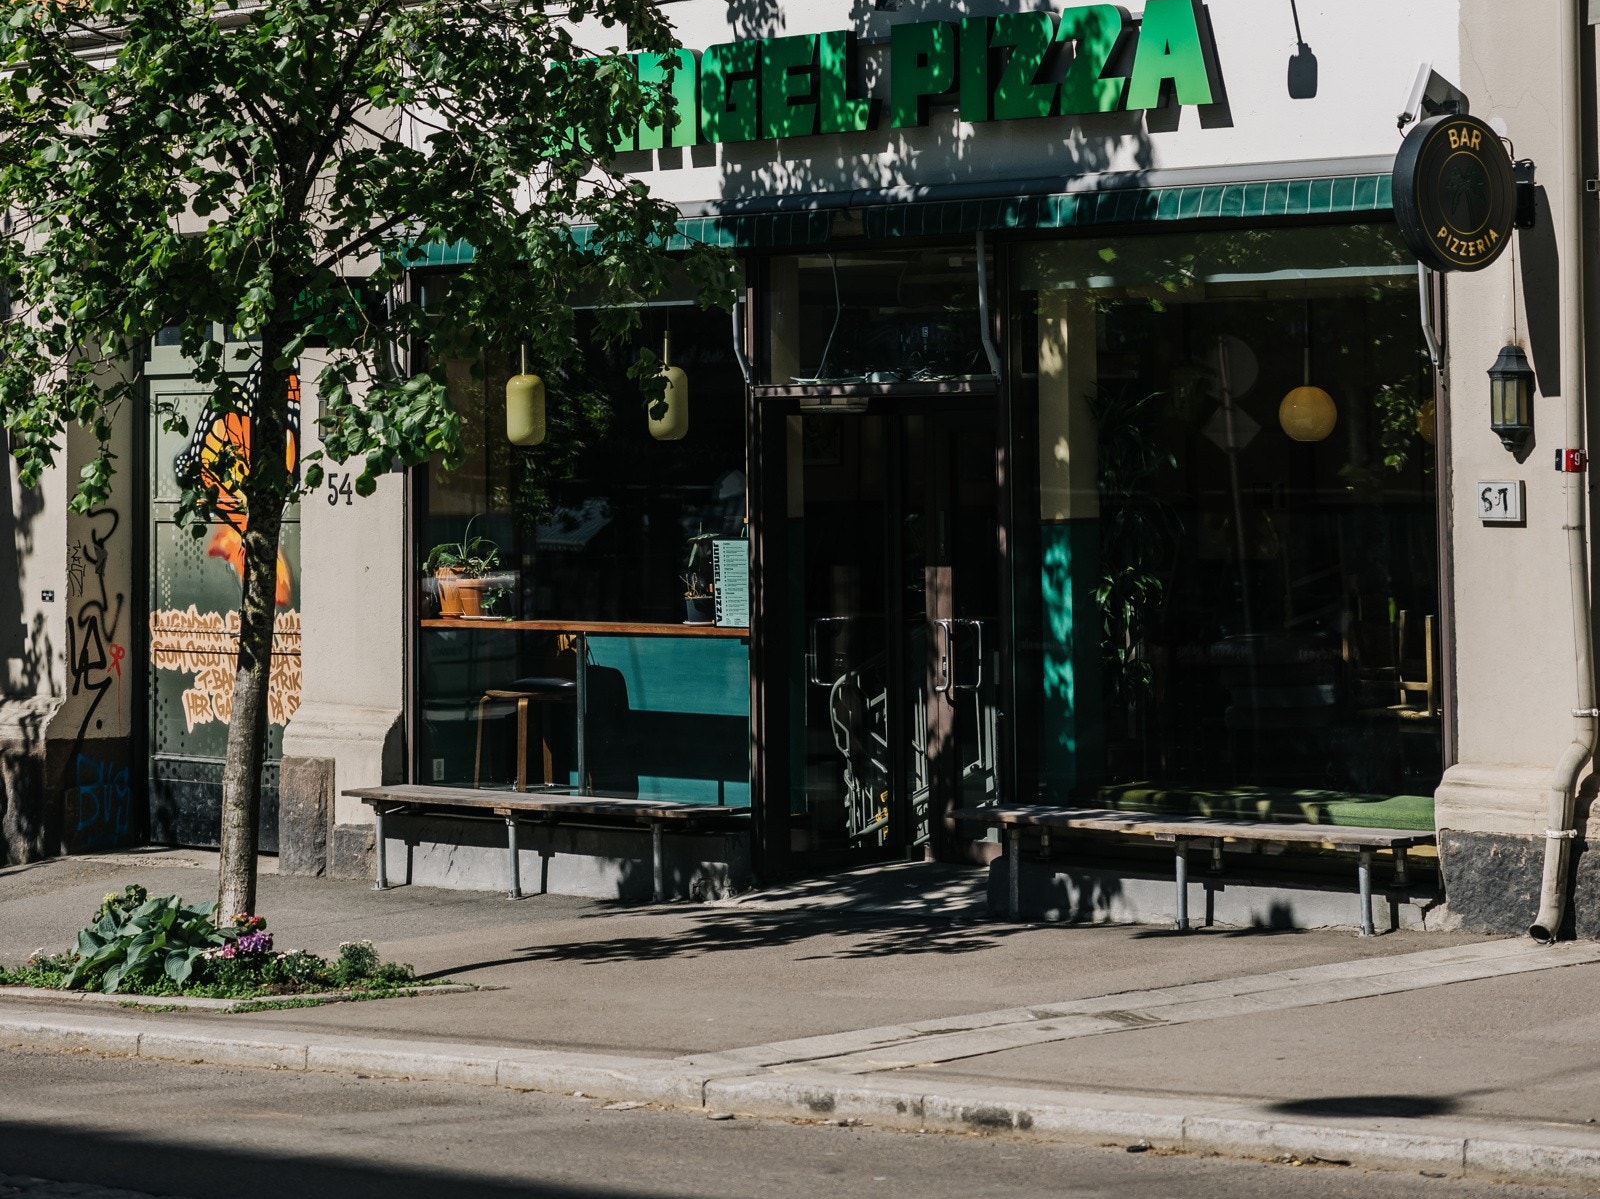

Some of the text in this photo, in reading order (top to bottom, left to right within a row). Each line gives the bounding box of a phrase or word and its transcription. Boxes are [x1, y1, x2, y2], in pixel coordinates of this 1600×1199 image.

[538, 30, 875, 158] NGEL
[1448, 127, 1482, 151] BAR
[1436, 226, 1499, 257] PIZZERIA
[327, 473, 353, 506] 54
[713, 542, 723, 623] JUNGEL PIZZA
[153, 640, 186, 667] SOM
[186, 640, 221, 668] OSLO
[186, 692, 212, 723] HER
[215, 689, 234, 720] GÅ
[269, 690, 285, 721] PÅ
